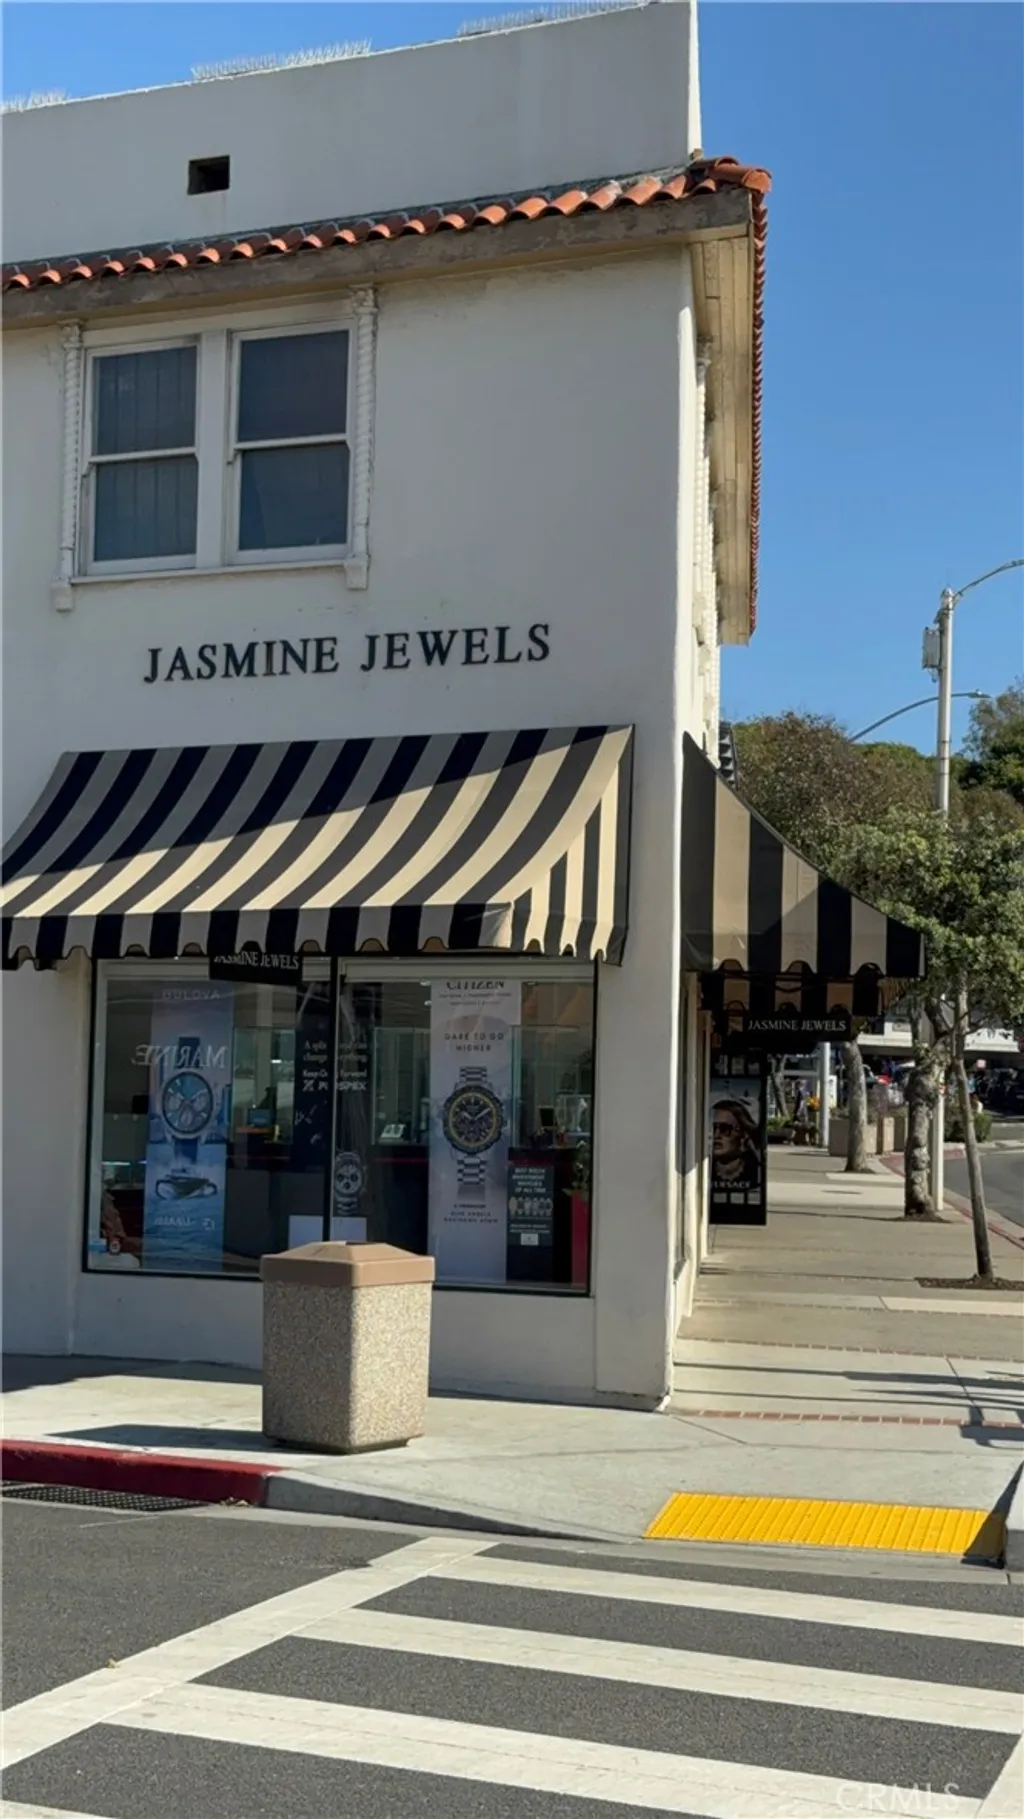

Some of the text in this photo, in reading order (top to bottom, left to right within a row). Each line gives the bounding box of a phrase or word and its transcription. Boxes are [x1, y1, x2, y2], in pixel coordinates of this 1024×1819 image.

[143, 623, 551, 684] JASMINE JEWELS
[260, 953, 299, 970] JEWELS
[748, 1019, 847, 1031] JASMINE JEWELS
